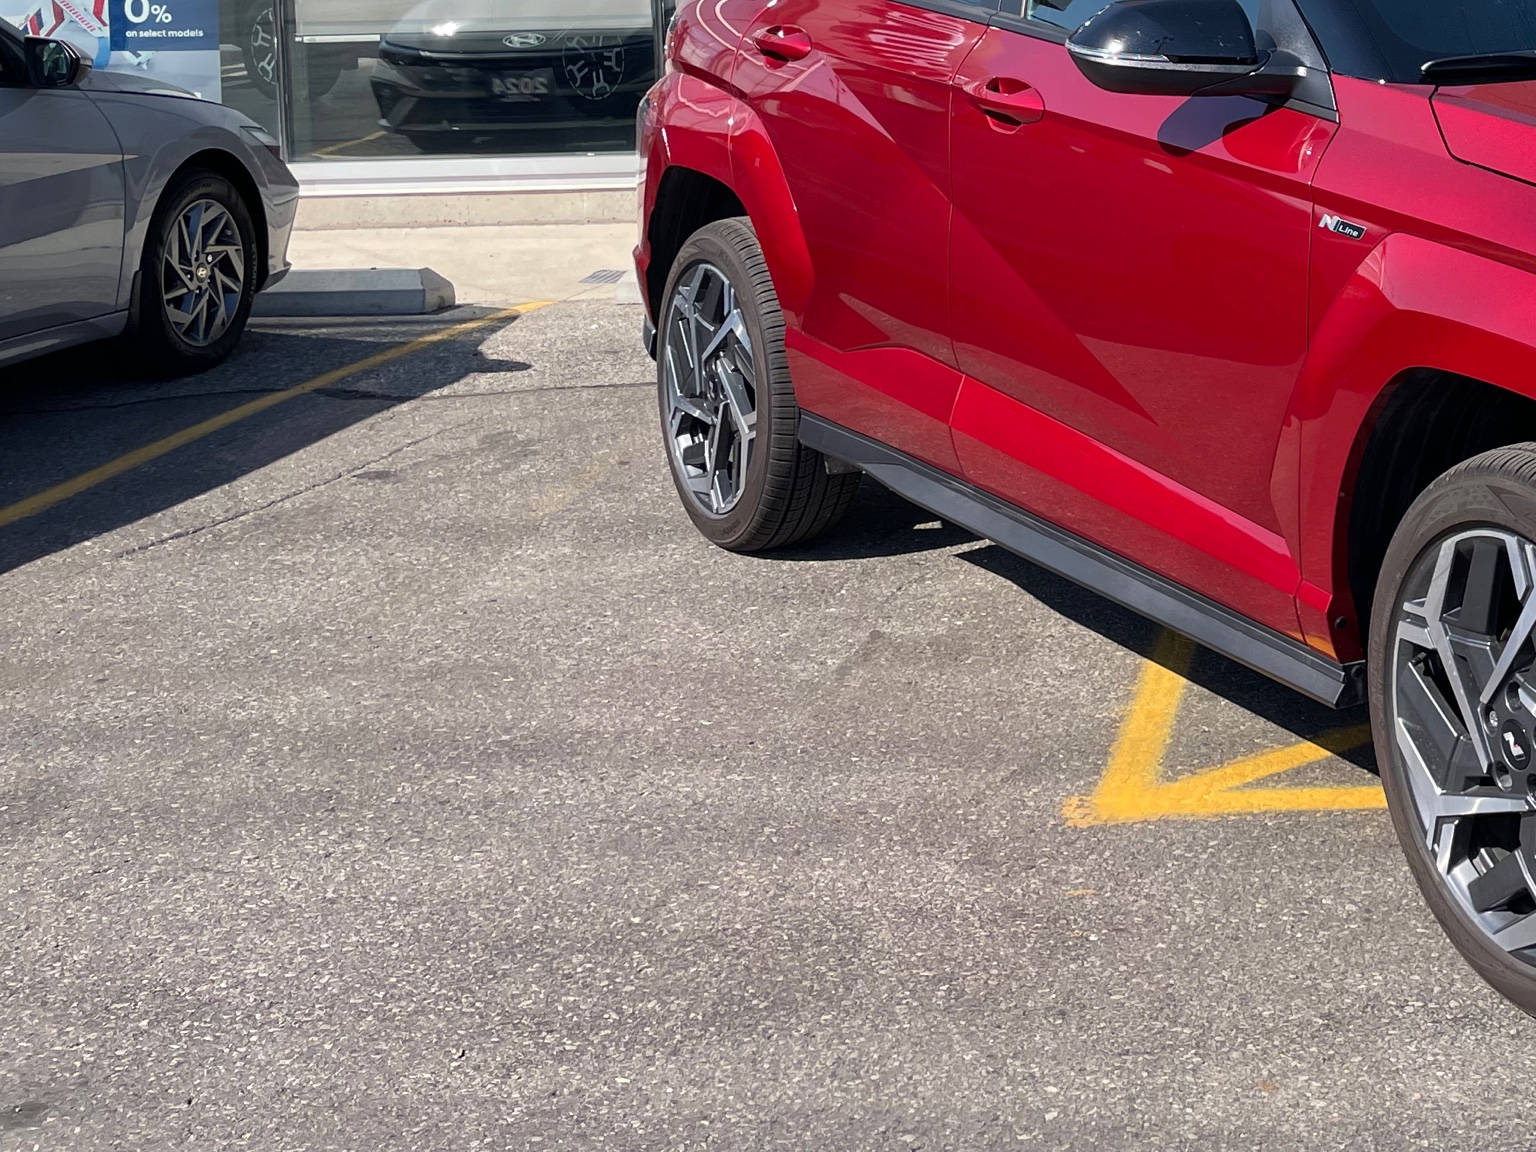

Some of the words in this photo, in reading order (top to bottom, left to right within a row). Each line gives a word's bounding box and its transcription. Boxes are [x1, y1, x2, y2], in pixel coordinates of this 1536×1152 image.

[125, 30, 138, 38] on
[139, 29, 167, 38] select
[168, 29, 204, 38] models
[1338, 225, 1359, 237] Line
